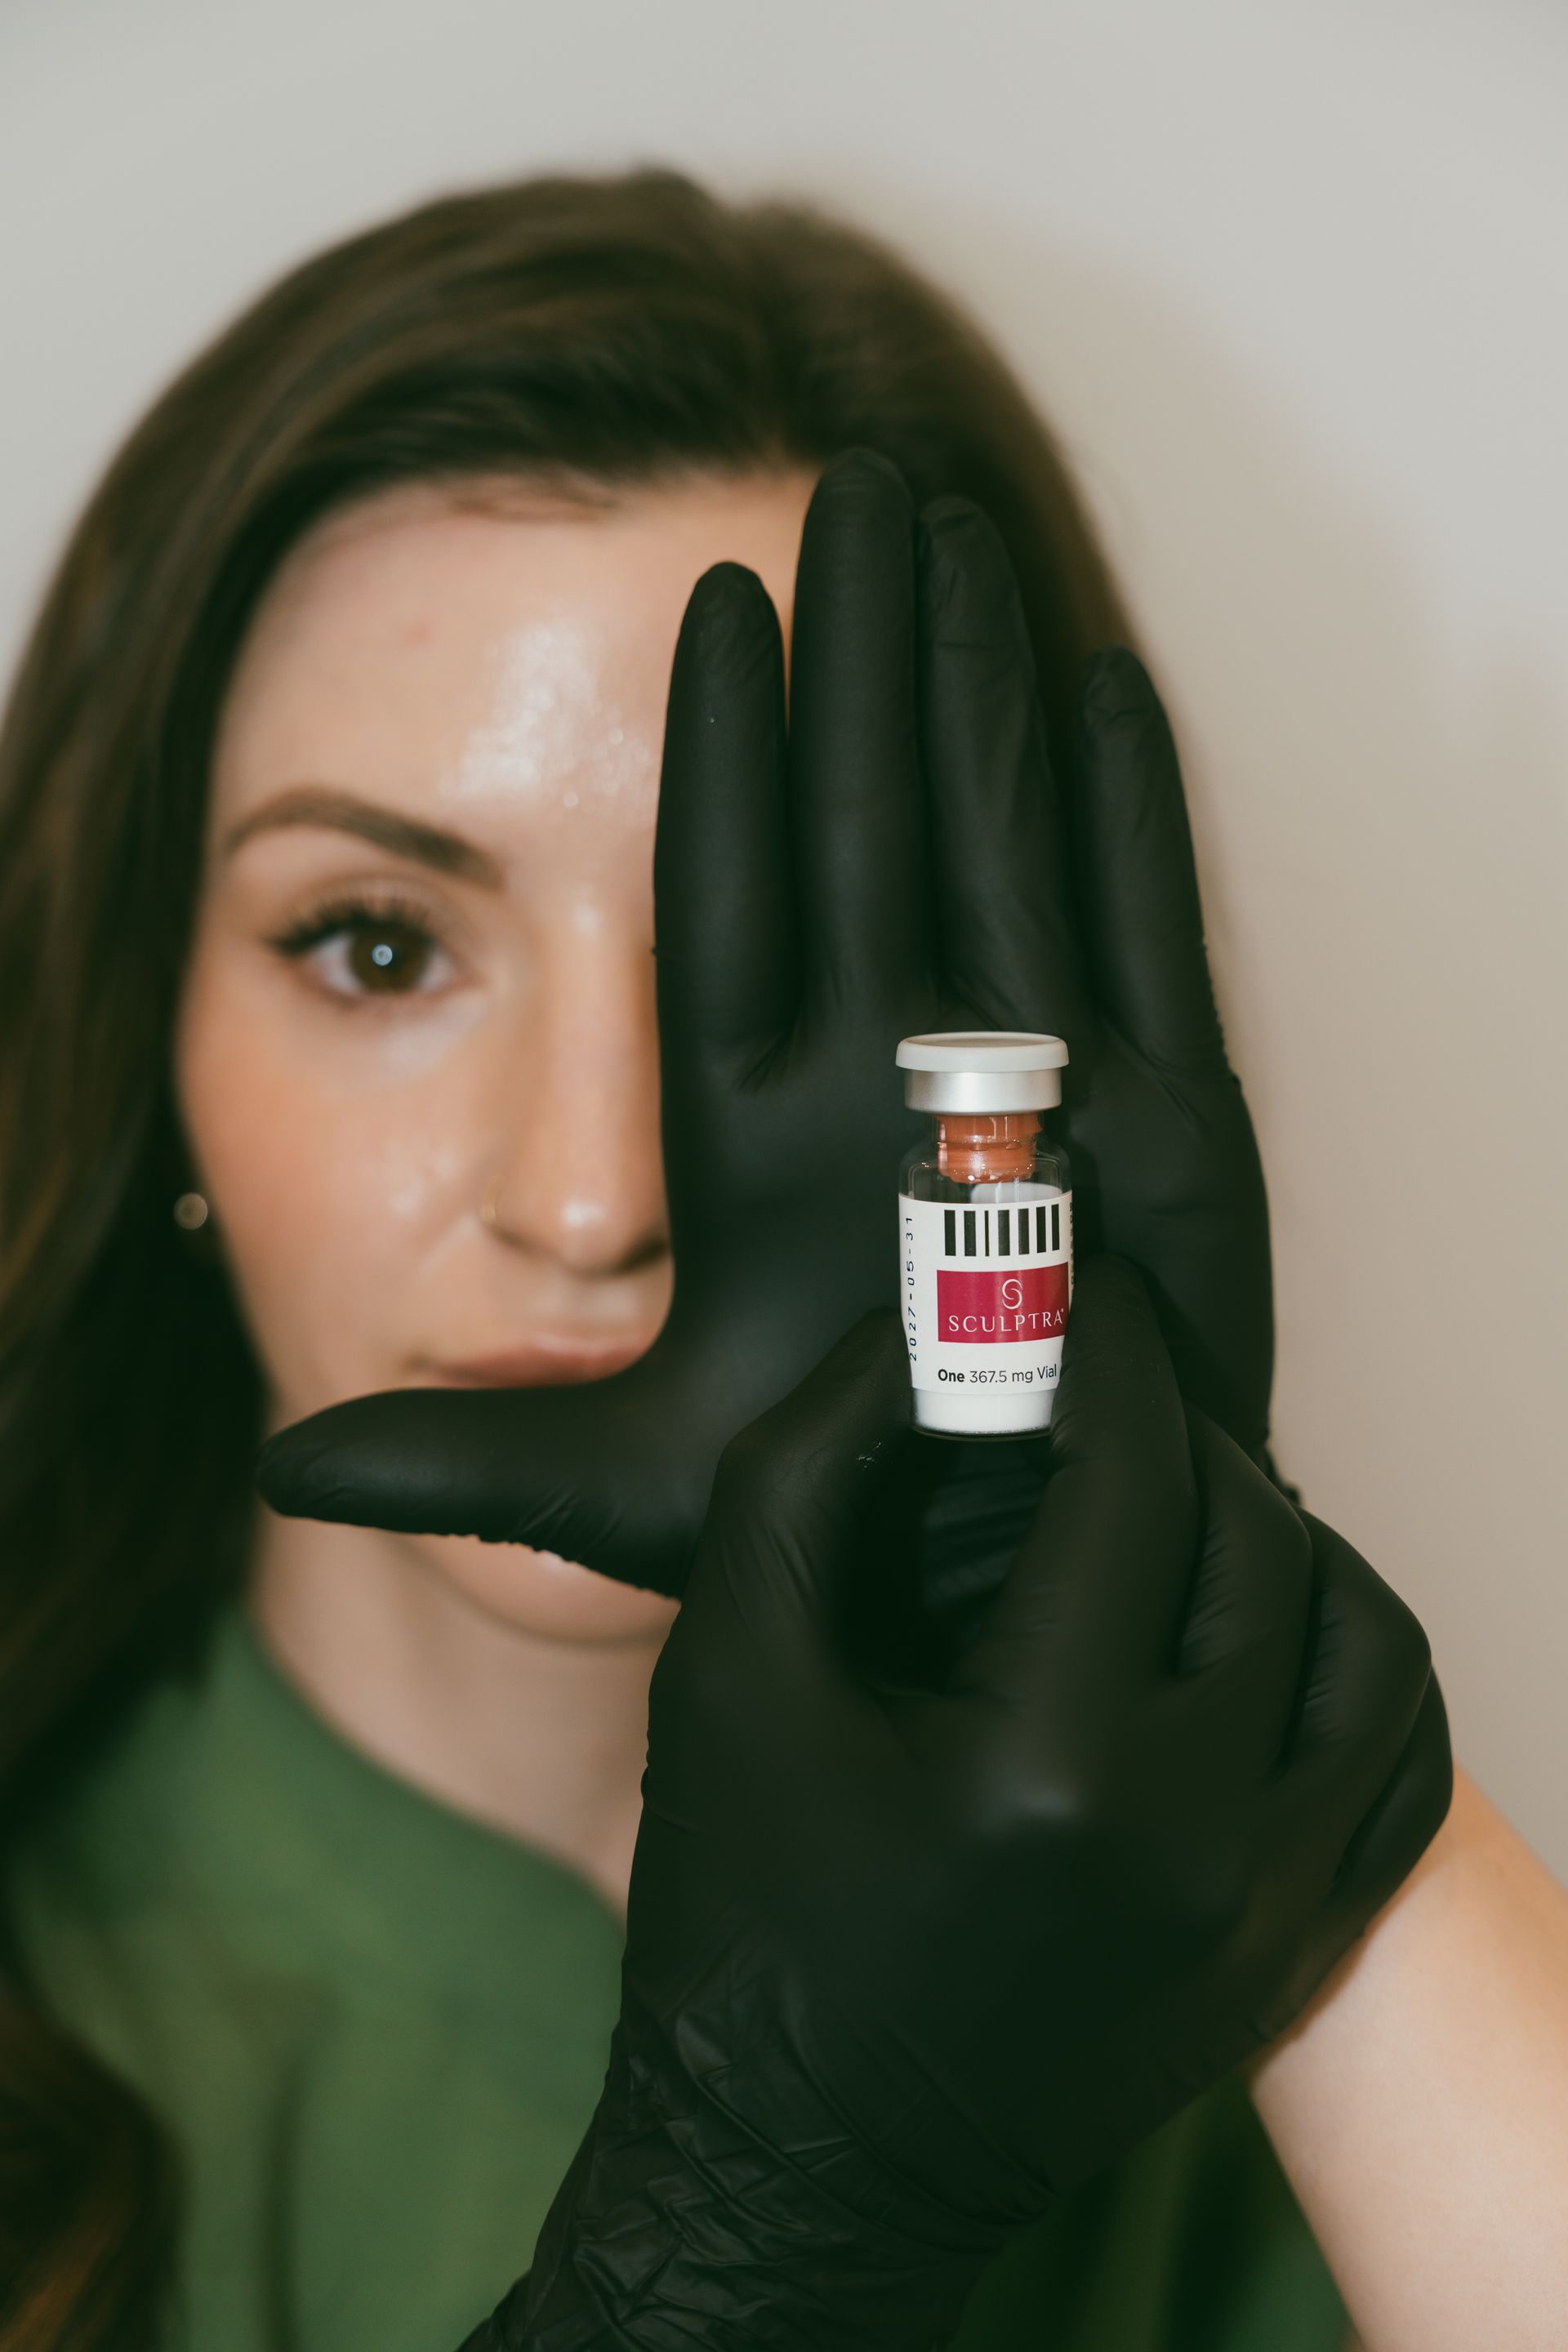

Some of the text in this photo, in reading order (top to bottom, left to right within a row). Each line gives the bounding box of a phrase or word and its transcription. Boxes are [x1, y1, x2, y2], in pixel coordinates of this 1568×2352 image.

[905, 1217, 917, 1361] 2027-05-31
[938, 1363, 1058, 1383] One 367.5 mg Vial
